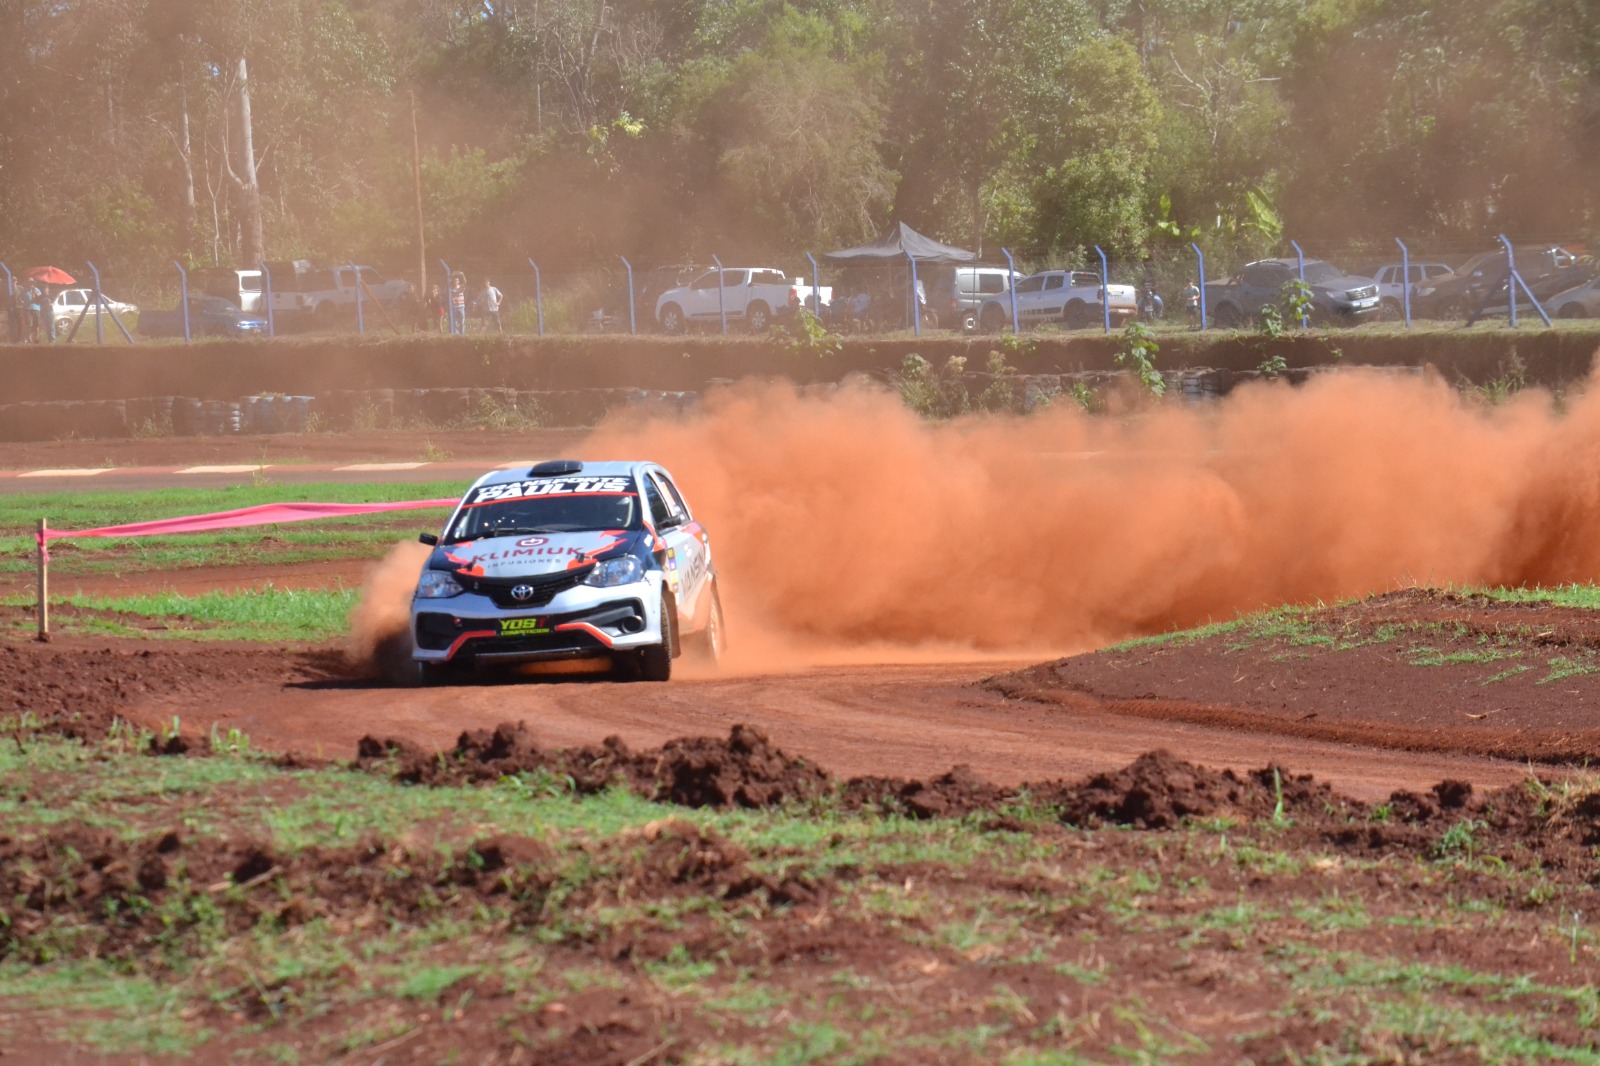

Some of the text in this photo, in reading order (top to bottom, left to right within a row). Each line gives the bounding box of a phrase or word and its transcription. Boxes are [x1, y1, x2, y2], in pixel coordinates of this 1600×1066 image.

[473, 482, 630, 503] PAULUS
[478, 477, 631, 493] TRANSPORTE
[471, 547, 584, 563] KLIMIUK
[487, 558, 561, 569] INFUSIONES
